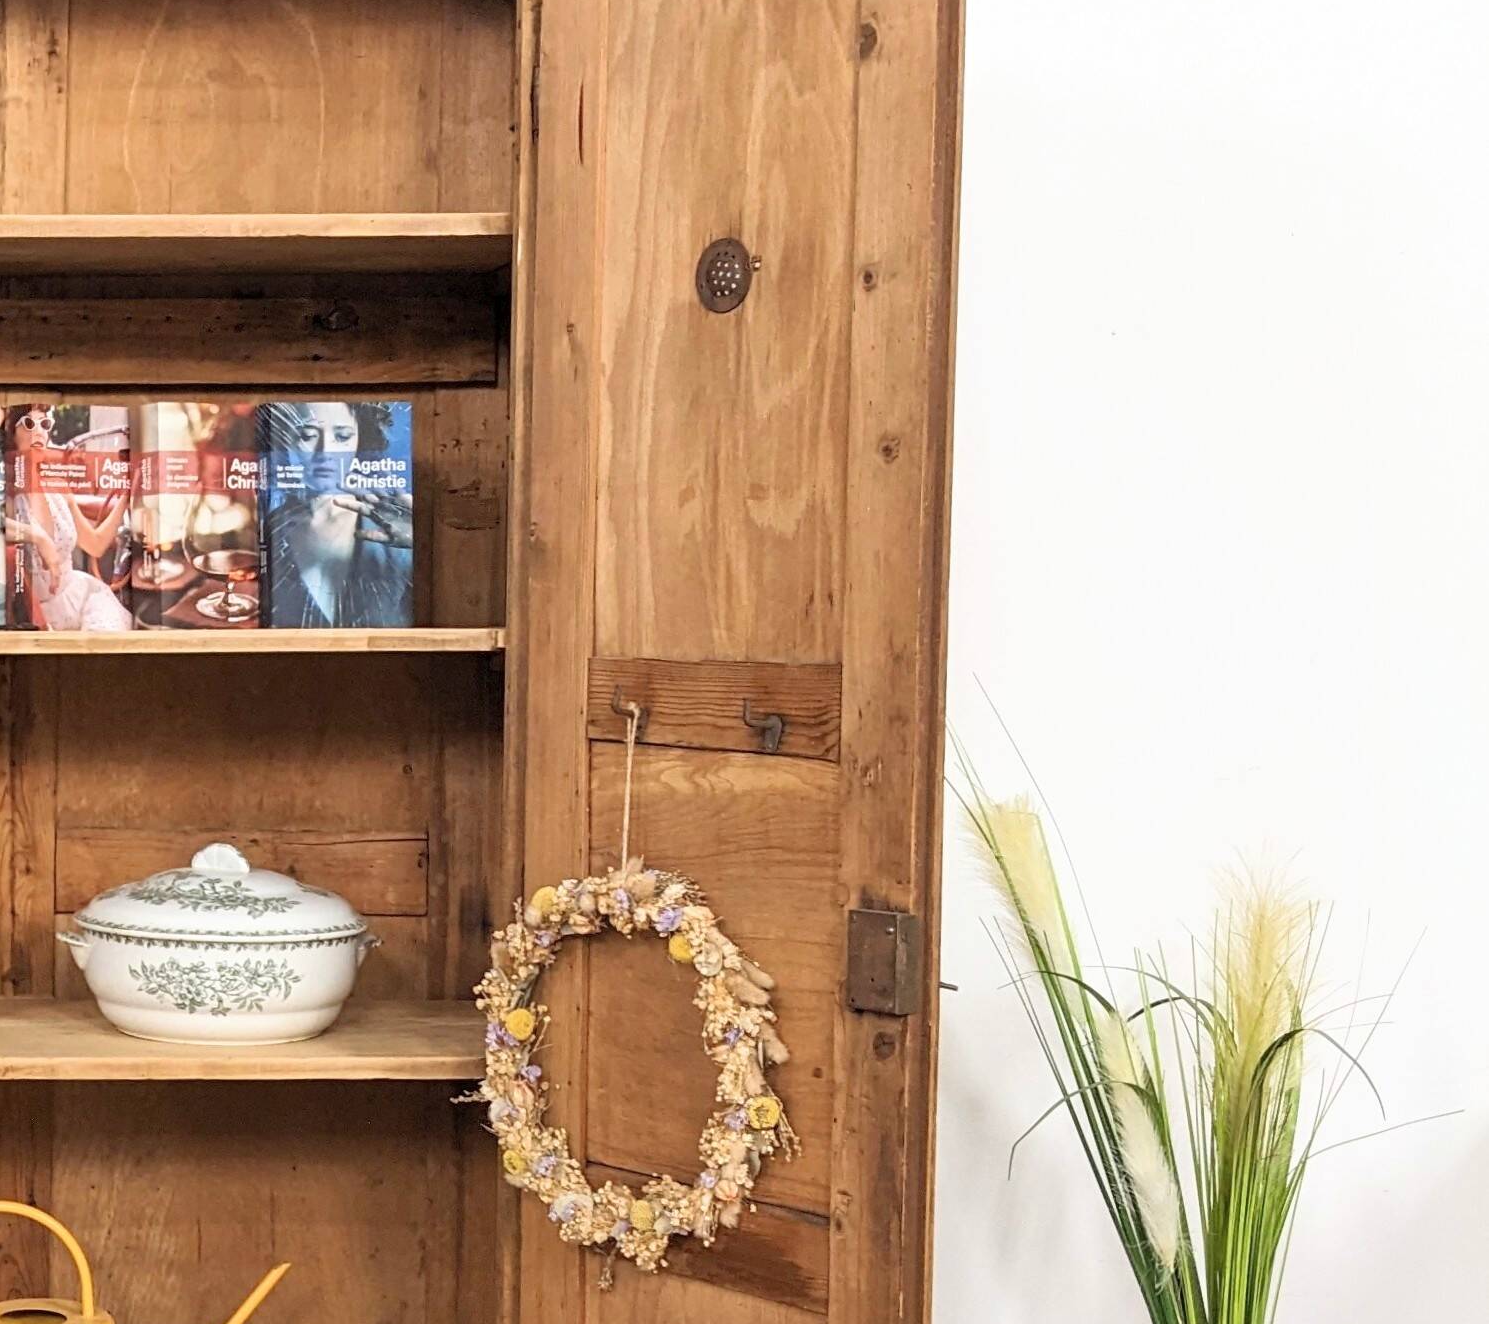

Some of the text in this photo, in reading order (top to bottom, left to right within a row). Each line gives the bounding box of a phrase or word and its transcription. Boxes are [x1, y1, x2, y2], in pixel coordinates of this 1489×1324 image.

[102, 458, 129, 475] Aga
[230, 458, 258, 475] Aga
[349, 457, 406, 474] Agatha
[99, 475, 131, 489] Chris
[345, 475, 406, 488] Christie
